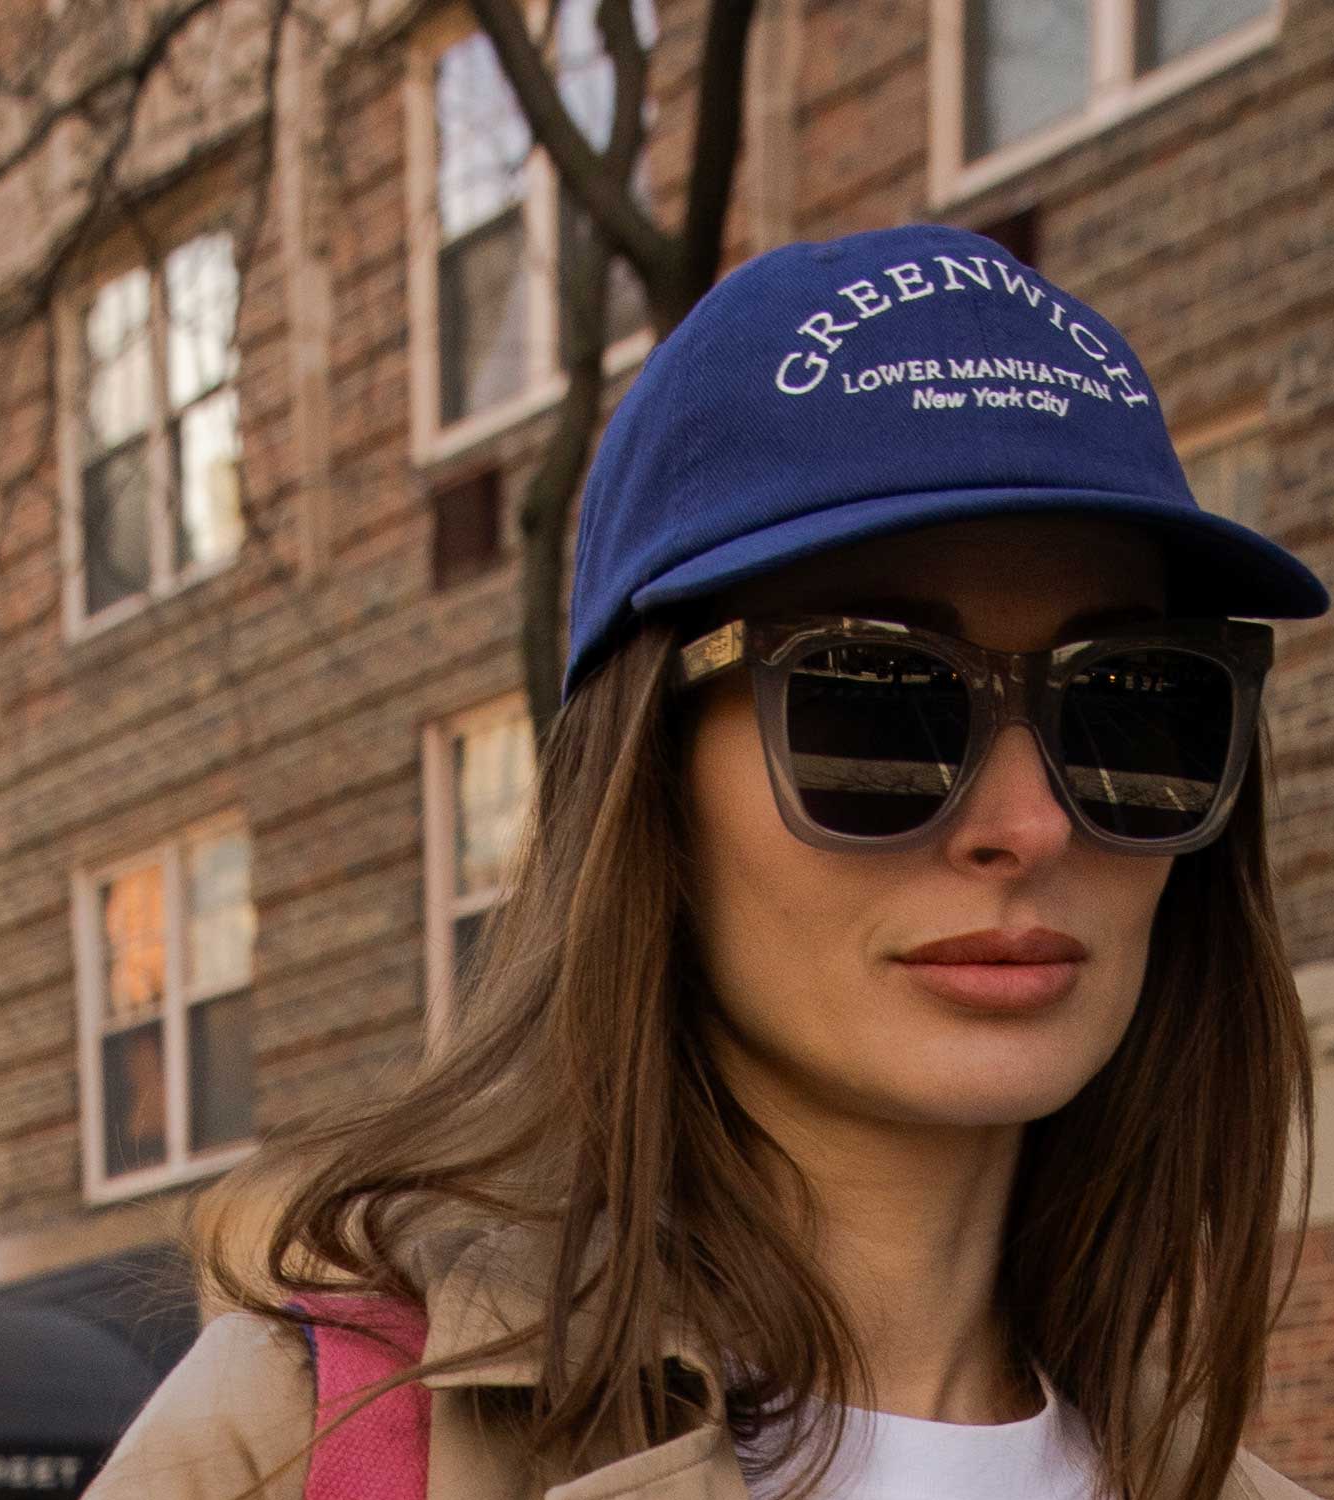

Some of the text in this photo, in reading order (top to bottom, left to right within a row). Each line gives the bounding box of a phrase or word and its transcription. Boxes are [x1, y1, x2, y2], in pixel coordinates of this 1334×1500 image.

[775, 255, 1149, 409] GREENWICH
[842, 357, 1113, 402] LOWER MANHATTAN
[912, 385, 1069, 417] New York City
